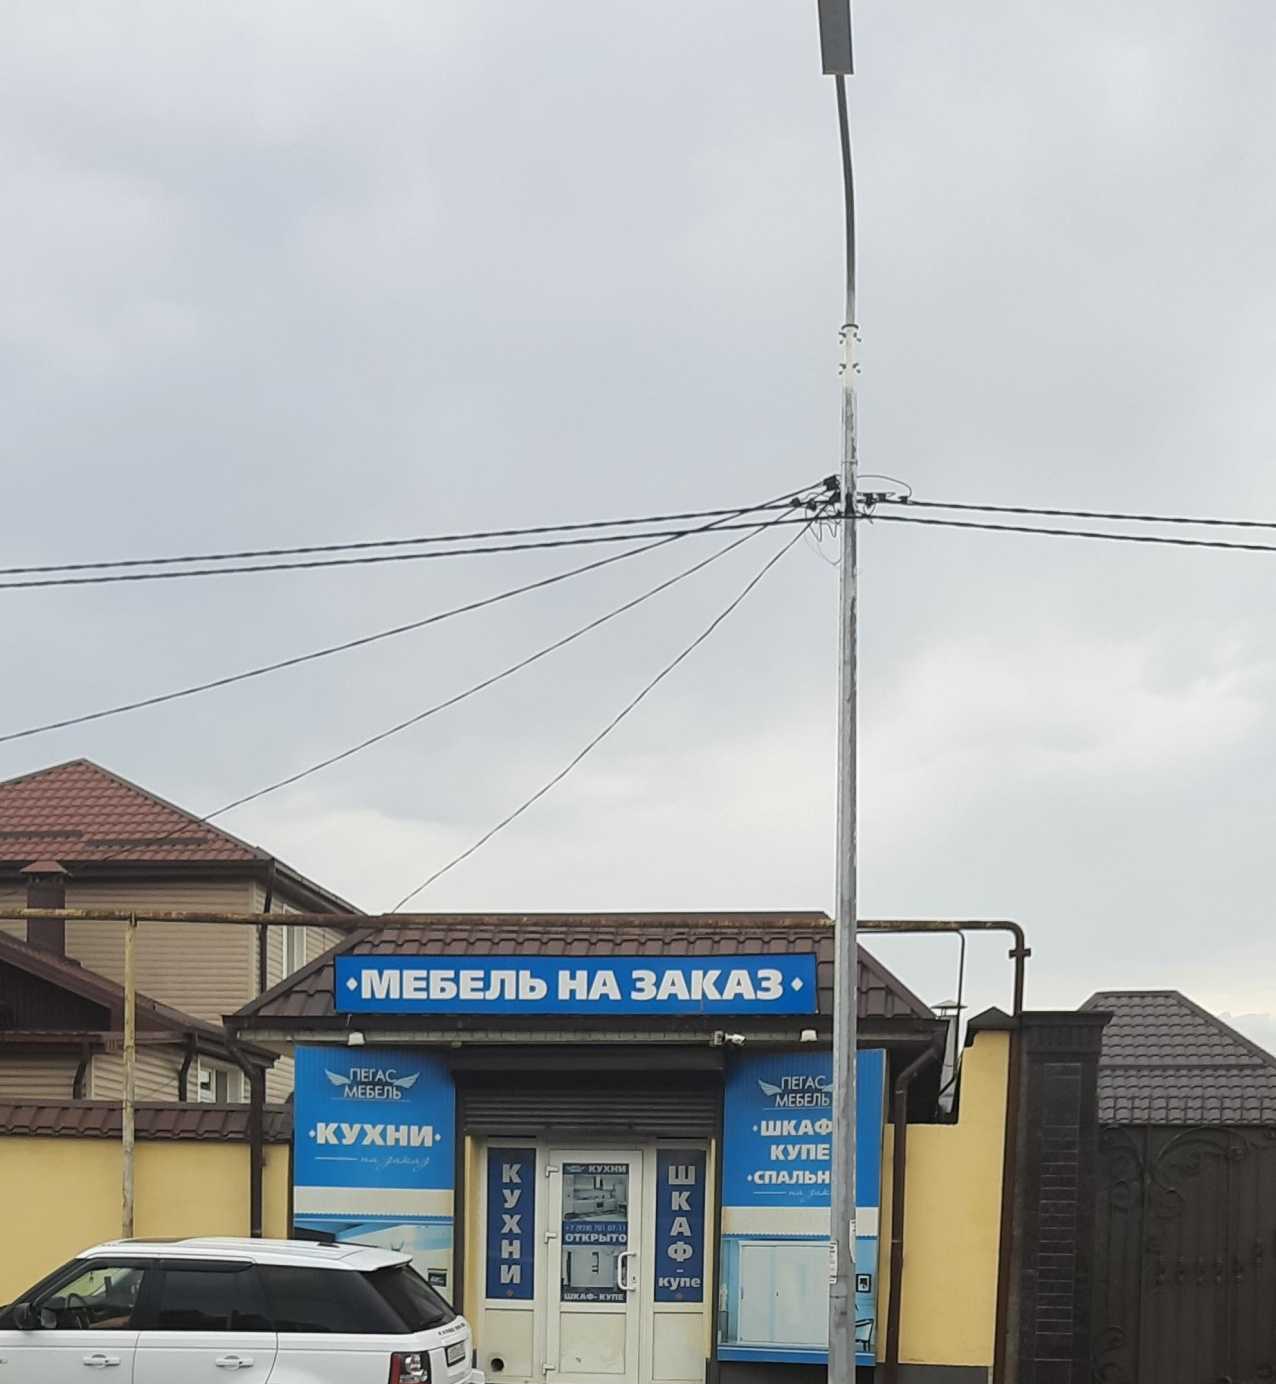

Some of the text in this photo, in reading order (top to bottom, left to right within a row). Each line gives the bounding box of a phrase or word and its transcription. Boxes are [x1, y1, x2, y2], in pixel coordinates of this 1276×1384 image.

[360, 968, 784, 1000] МЕБЕЛЬ НА ЗАКАЗ
[349, 1067, 398, 1083] ПЕГАС
[781, 1075, 827, 1090] ПЕГАС
[343, 1085, 402, 1100] МЕБЕЛЬ
[775, 1092, 831, 1107] МЕБЕЛЬ
[316, 1122, 434, 1148] КУХНИ
[770, 1143, 831, 1161] КУПЕ
[588, 1164, 627, 1174] КУХНИ
[753, 1170, 832, 1185] СПАЛЬН
[501, 1162, 522, 1284] КУХНИ
[565, 1233, 627, 1243] ОТКРЫТО
[658, 1277, 701, 1291] купе
[599, 1292, 625, 1301] КУПЕ
